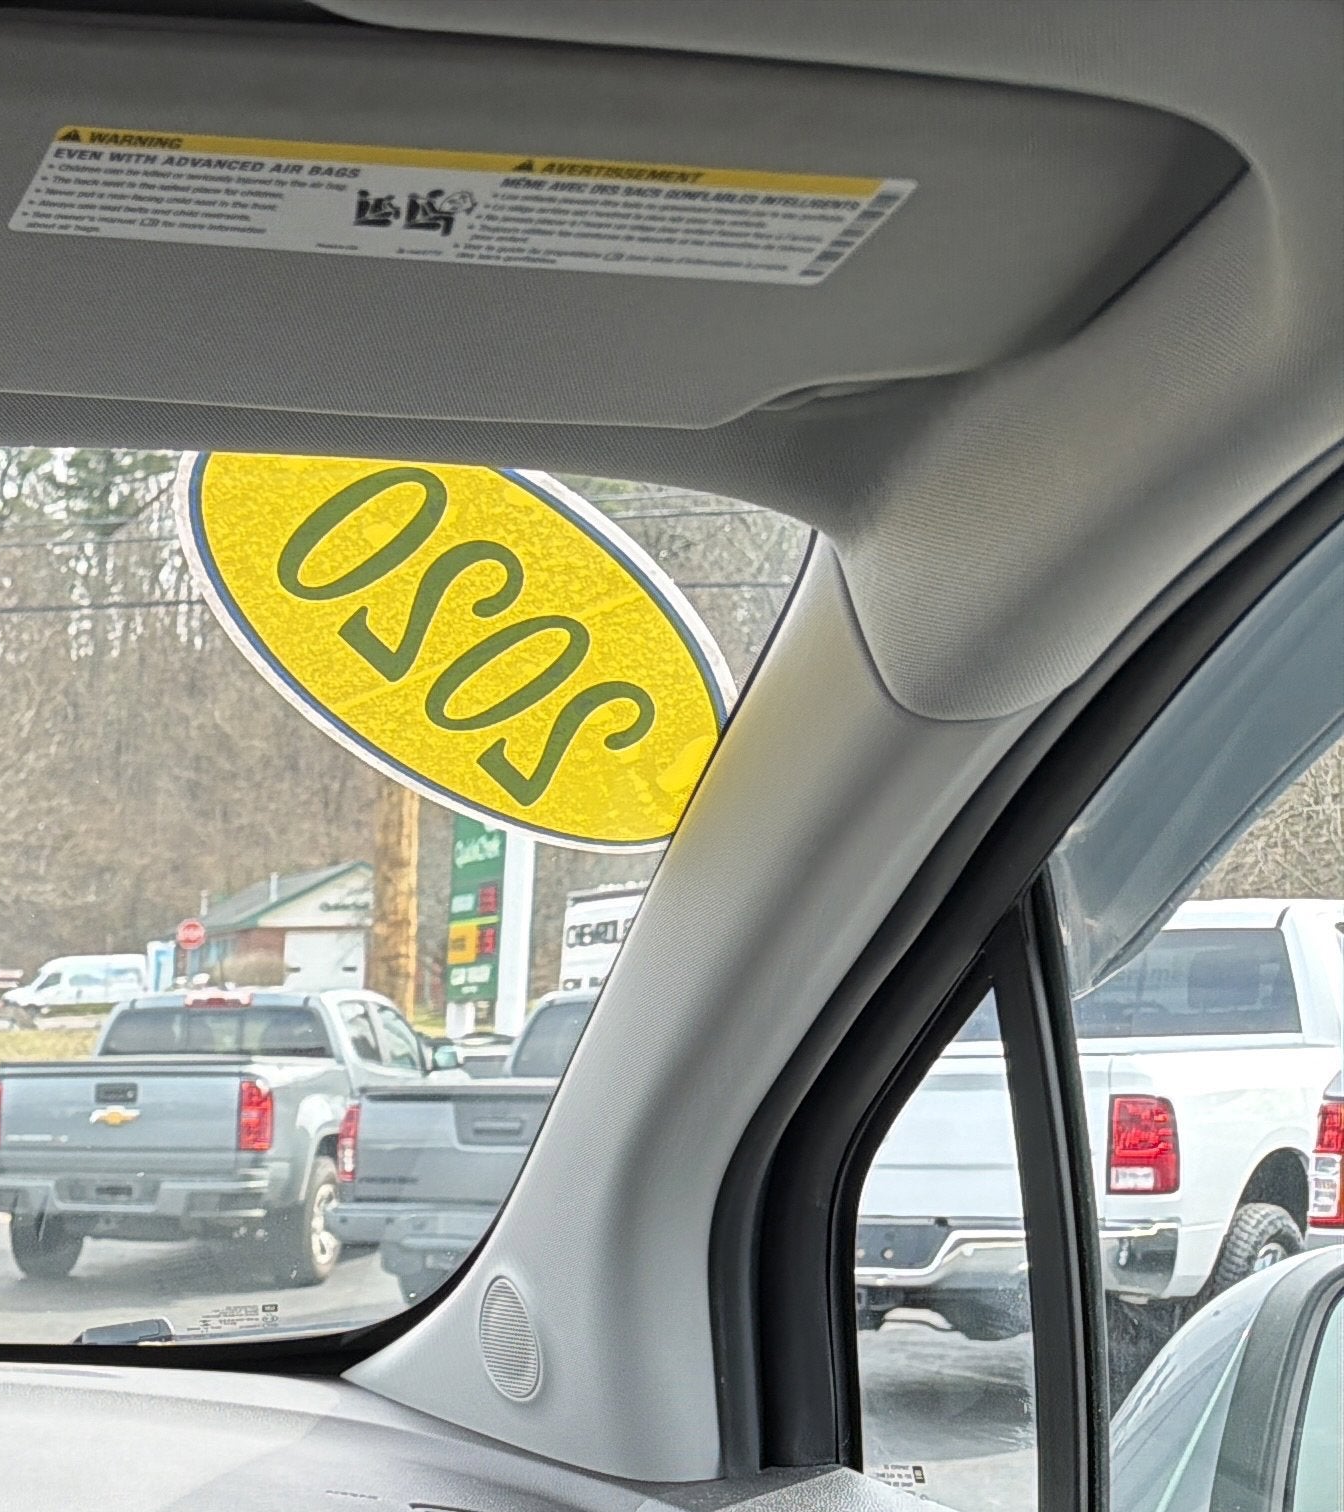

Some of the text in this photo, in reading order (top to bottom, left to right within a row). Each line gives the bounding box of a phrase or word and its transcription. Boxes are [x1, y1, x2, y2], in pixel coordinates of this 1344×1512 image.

[90, 131, 185, 150] WARNING
[53, 148, 362, 179] EVEN WITH ADVANCED AIR BAGS
[540, 161, 707, 184] AVERTISSEMENT
[549, 180, 589, 194] AVEC
[589, 183, 621, 196] DES
